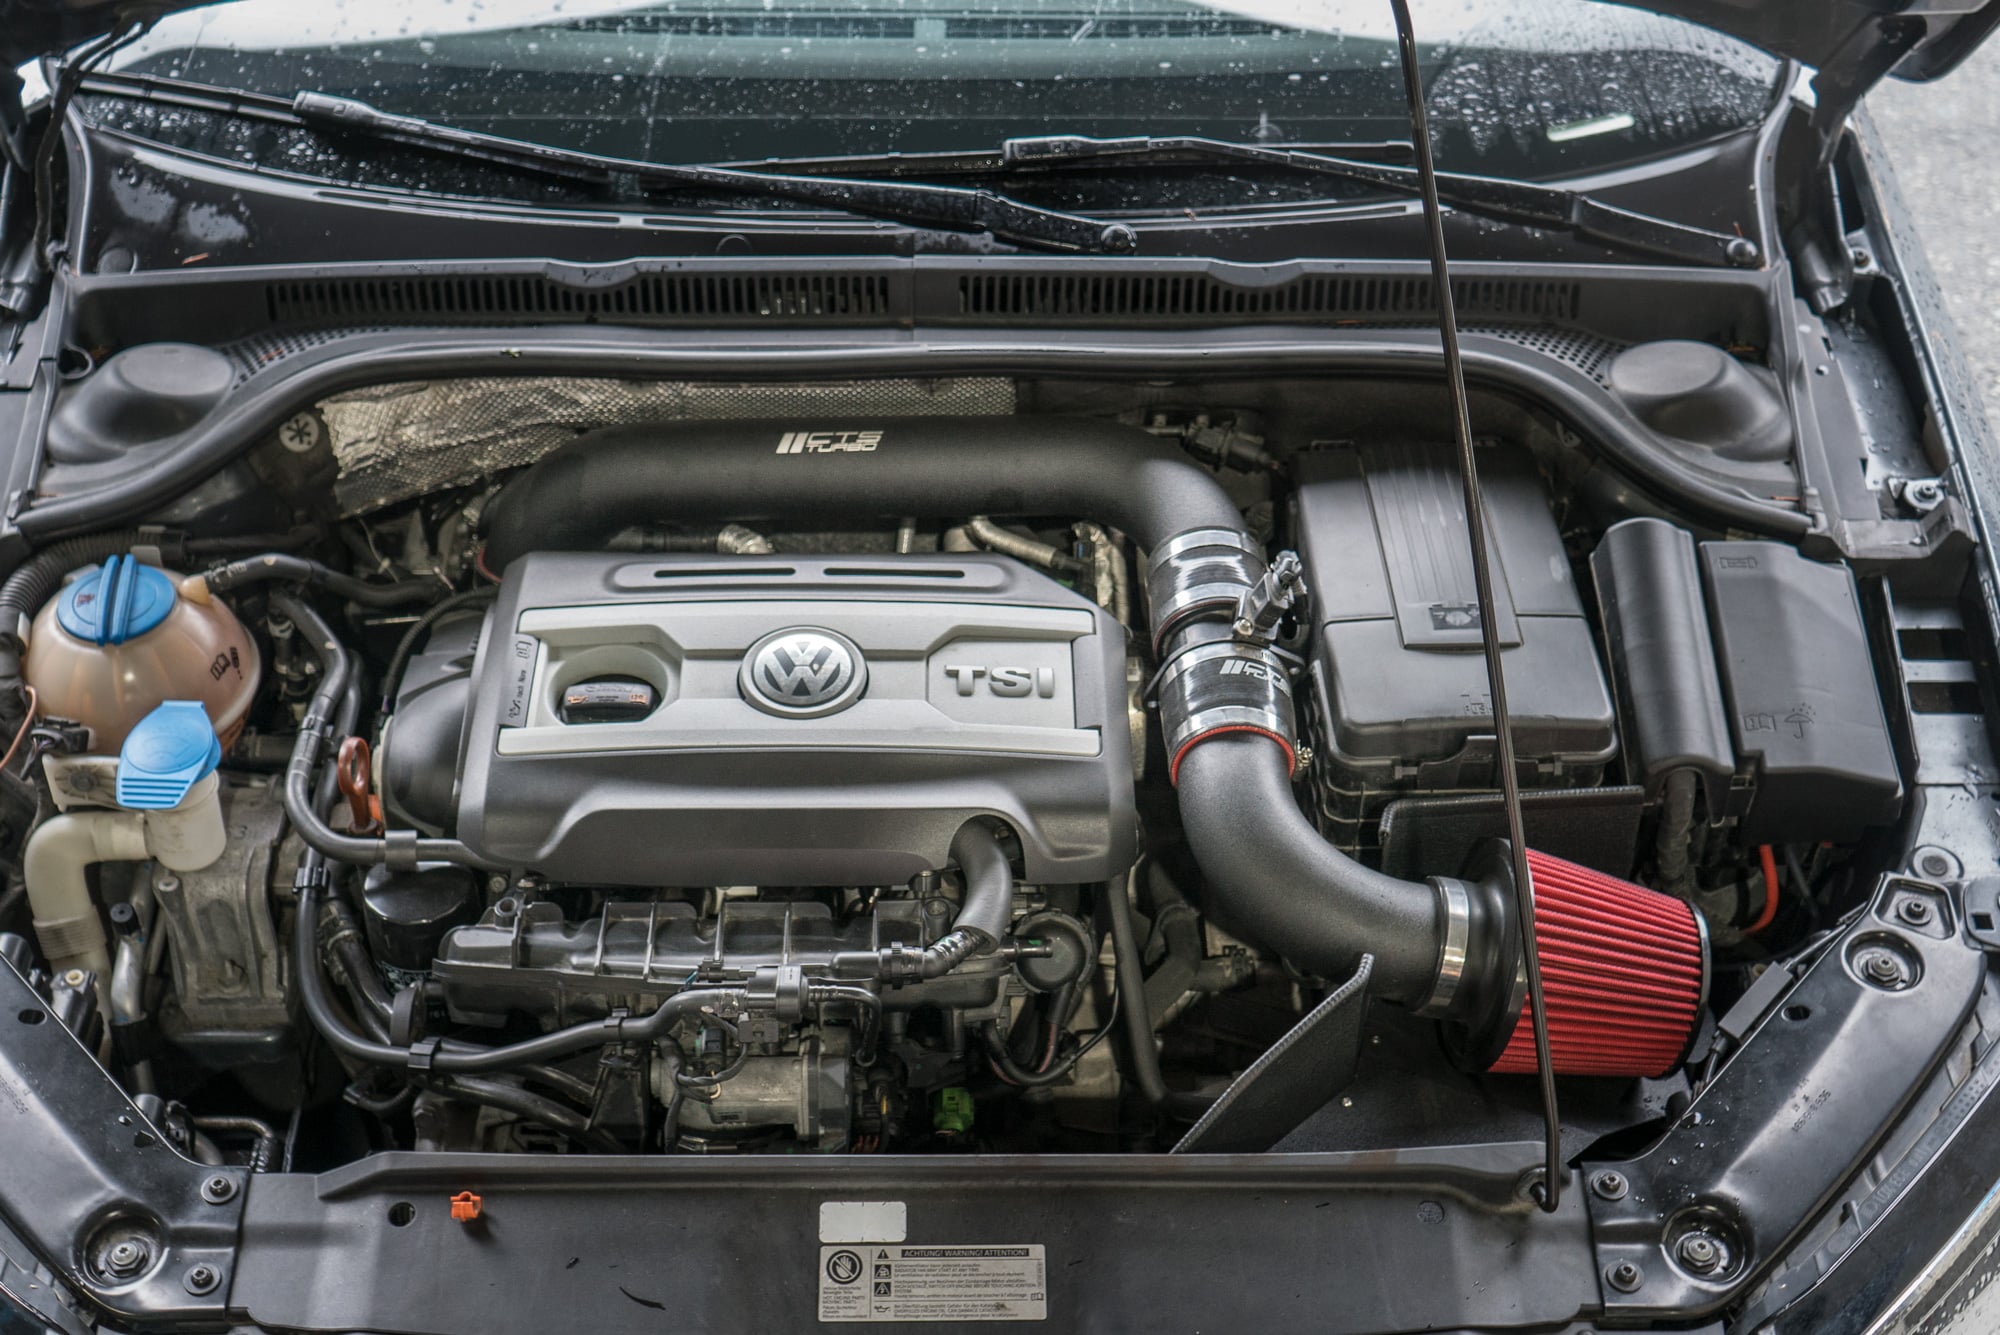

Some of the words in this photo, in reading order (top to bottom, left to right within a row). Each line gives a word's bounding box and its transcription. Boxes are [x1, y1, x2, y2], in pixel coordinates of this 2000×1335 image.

[807, 431, 884, 444] CTS
[806, 442, 878, 453] TURBO
[752, 632, 856, 707] VW
[944, 665, 1055, 699] TSI
[904, 1249, 943, 1257] ACHTUNG!
[944, 1249, 983, 1257] WARNING!
[984, 1248, 1028, 1257] ATTENTION!
